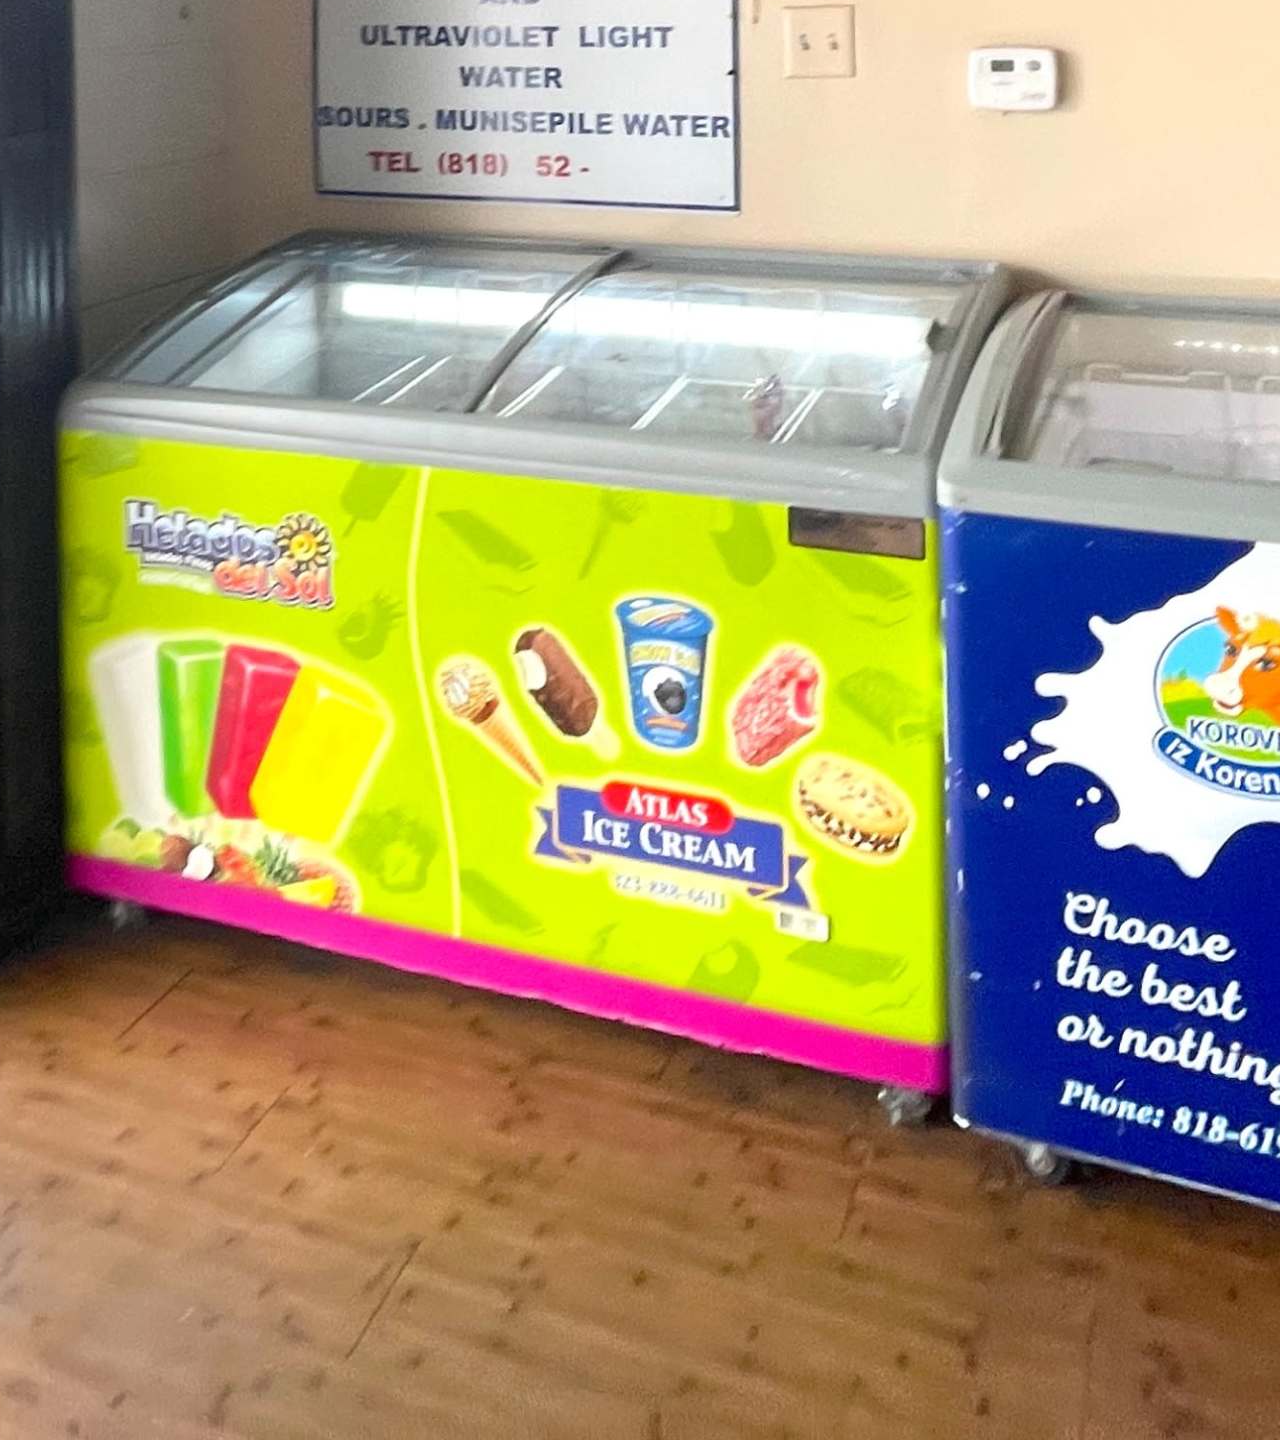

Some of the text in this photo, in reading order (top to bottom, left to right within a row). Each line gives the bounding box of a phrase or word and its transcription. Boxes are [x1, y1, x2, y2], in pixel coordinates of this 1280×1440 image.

[360, 25, 673, 48] ULTRAVIOLET LIGHT
[459, 66, 562, 89] WATER
[435, 109, 613, 135] MUNISEPILE
[623, 114, 731, 138] WATER
[367, 150, 420, 173] TEL
[437, 152, 508, 177] (818)
[126, 500, 280, 563] Helados
[213, 558, 270, 598] del
[274, 558, 334, 606] Sol
[624, 787, 708, 827] ATLAS
[583, 810, 756, 873] ICE CREAM
[1064, 891, 1237, 962] Choose
[1056, 946, 1247, 1022] the best
[1057, 1014, 1114, 1048] or
[1059, 1078, 1166, 1129] Phone:
